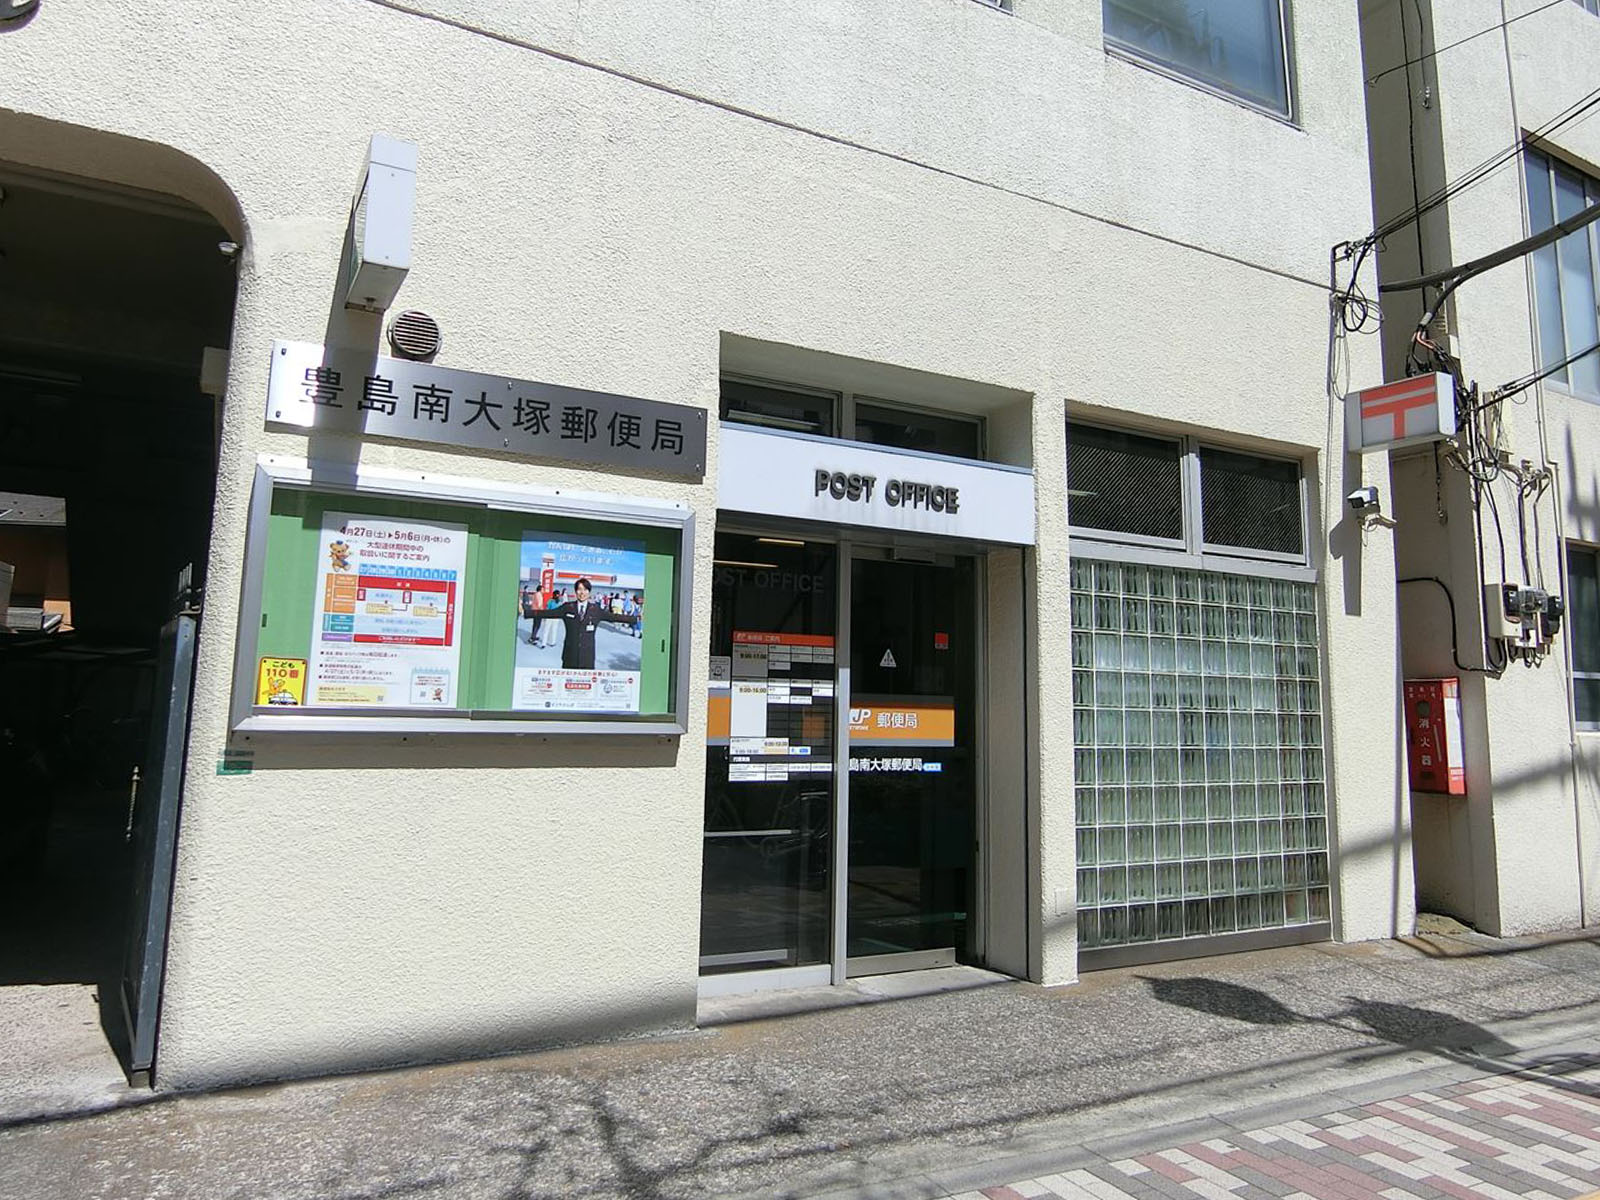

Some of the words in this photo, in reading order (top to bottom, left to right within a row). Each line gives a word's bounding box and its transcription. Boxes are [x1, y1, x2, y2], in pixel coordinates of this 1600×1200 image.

[299, 366, 684, 455] 豊島南大塚郵便局
[815, 469, 877, 504] POST
[885, 479, 960, 514] OFFICE
[272, 661, 295, 669] こども
[876, 712, 919, 729] 郵便局
